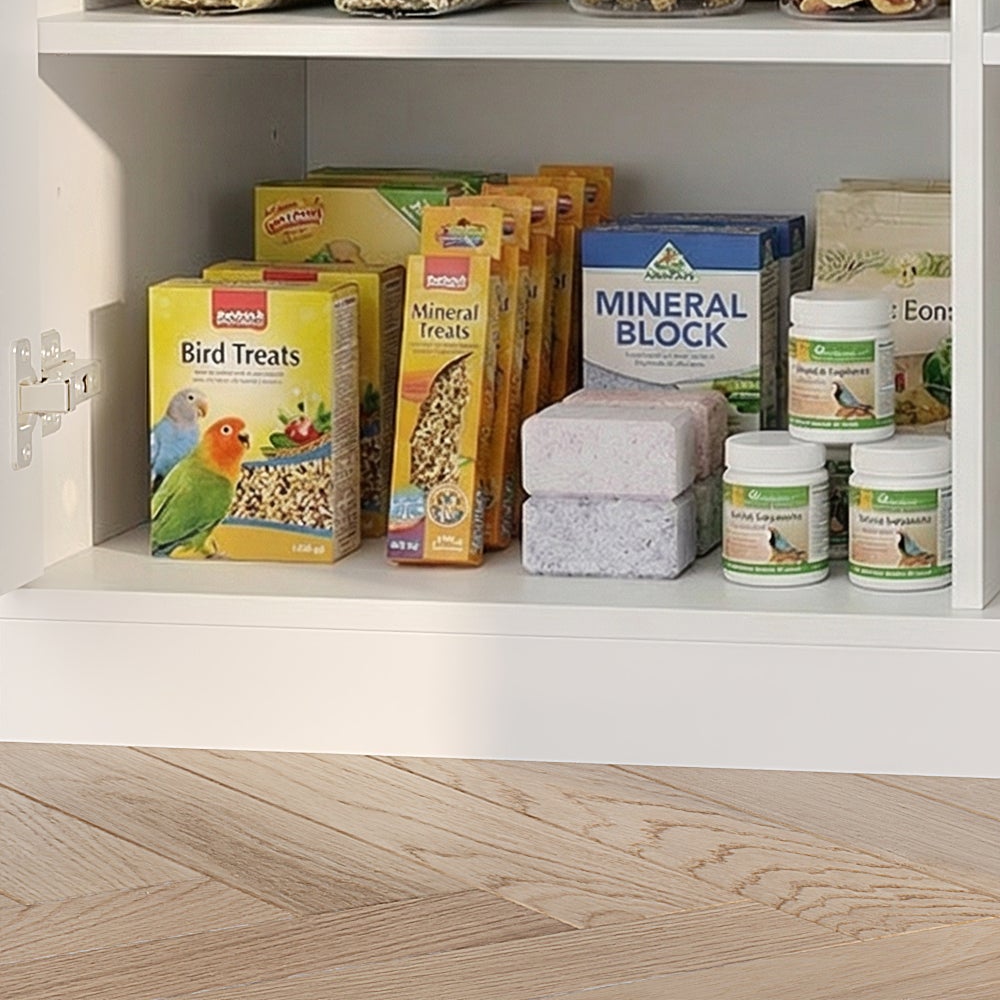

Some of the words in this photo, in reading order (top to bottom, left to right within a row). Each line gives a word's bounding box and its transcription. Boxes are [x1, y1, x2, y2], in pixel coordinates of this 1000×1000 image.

[412, 302, 479, 320] Mineral
[596, 290, 748, 318] MINERAL
[904, 299, 953, 321] Eon
[420, 322, 470, 339] Treats
[616, 320, 728, 348] BLOCK
[181, 341, 225, 364] Bird
[231, 343, 300, 367] Treats
